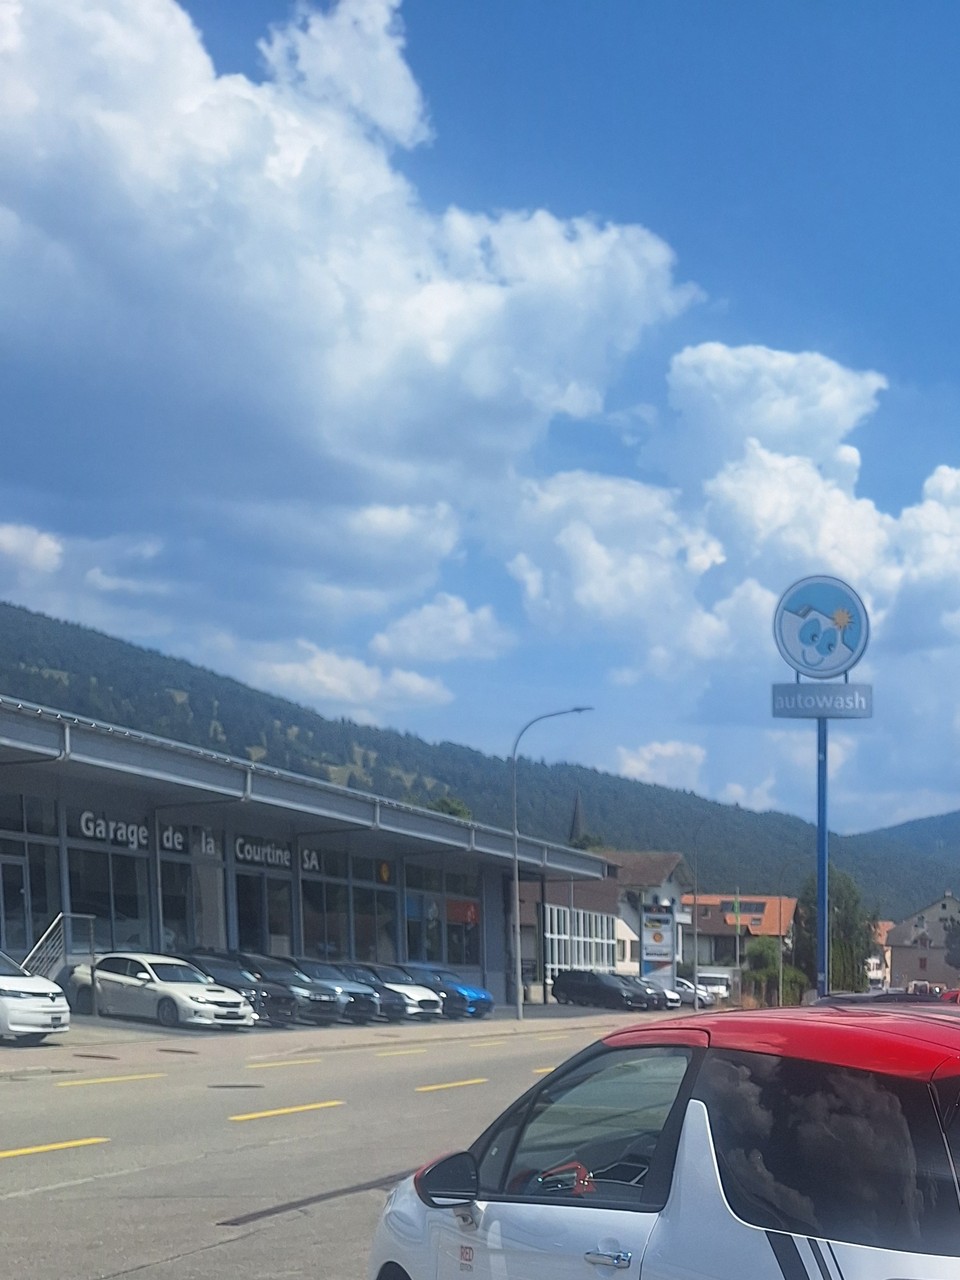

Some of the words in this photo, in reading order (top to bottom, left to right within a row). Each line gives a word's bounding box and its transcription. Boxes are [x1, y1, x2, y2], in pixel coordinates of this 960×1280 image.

[774, 692, 866, 709] autowash
[80, 811, 148, 850] Garage
[163, 826, 183, 850] de
[201, 831, 215, 855] la
[236, 838, 291, 866] Courtine
[303, 849, 319, 870] SA
